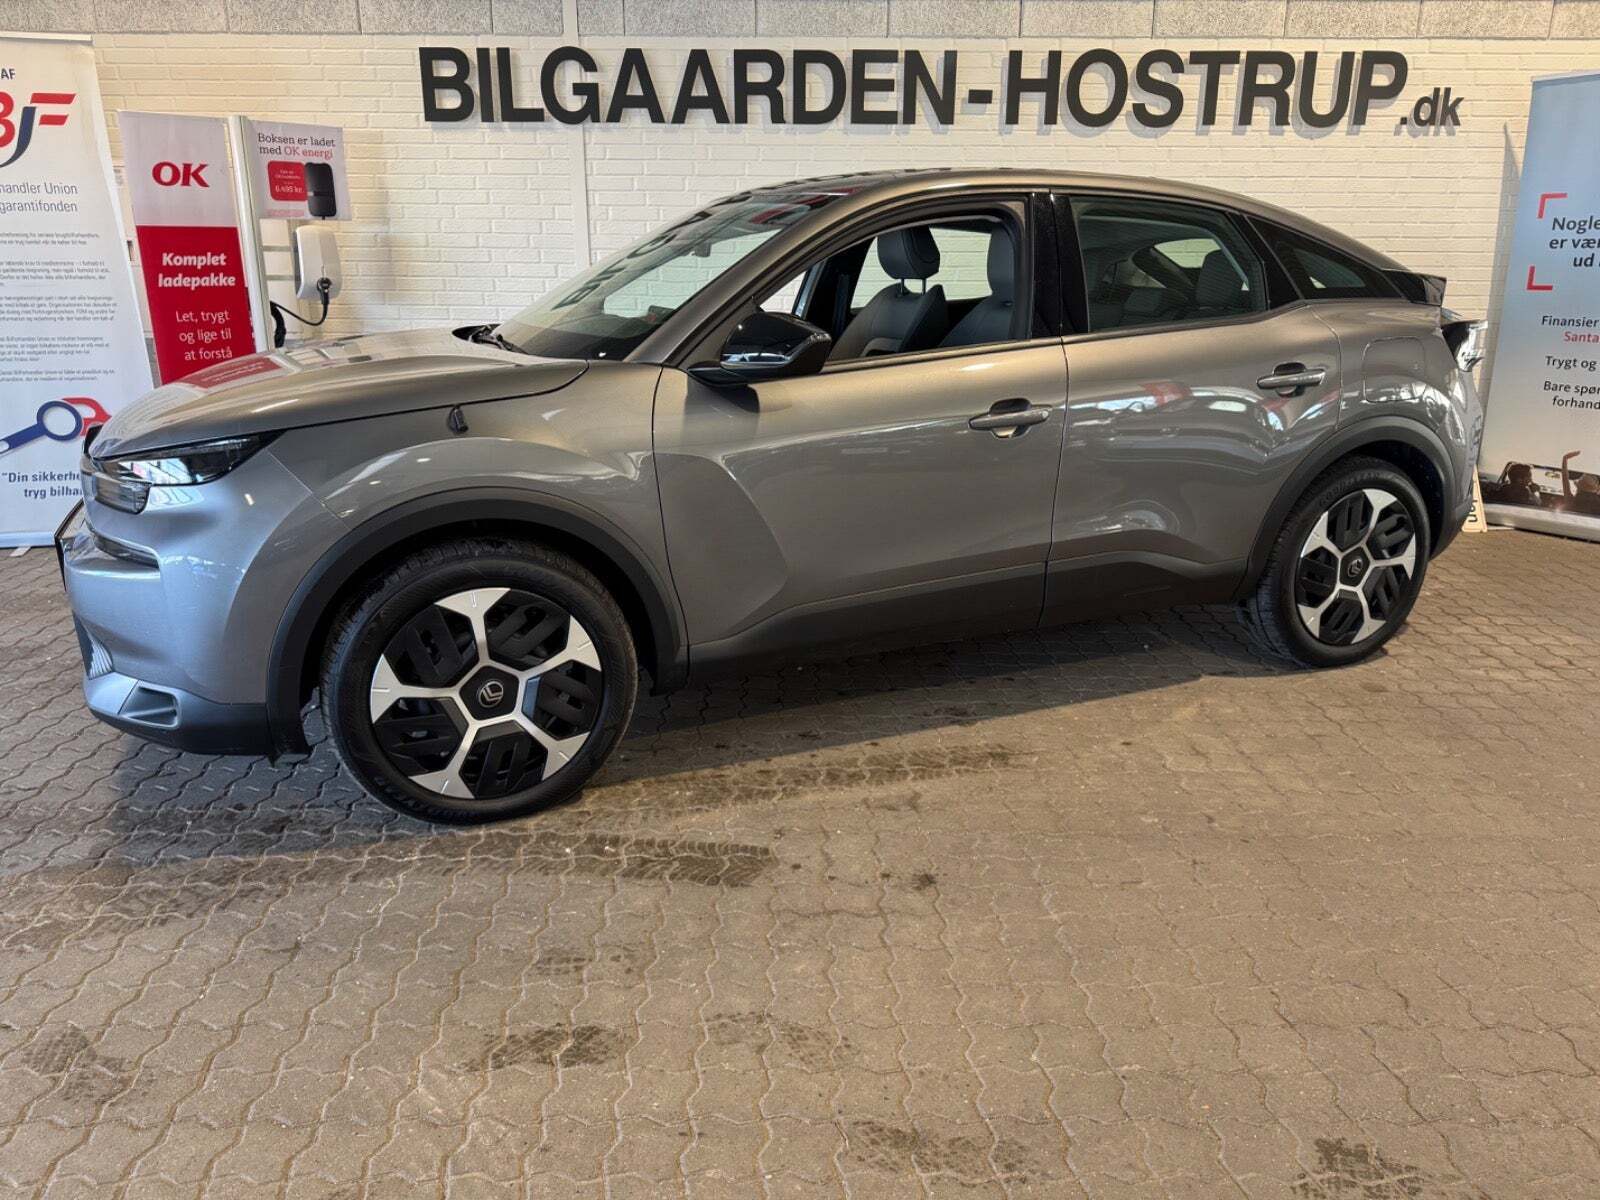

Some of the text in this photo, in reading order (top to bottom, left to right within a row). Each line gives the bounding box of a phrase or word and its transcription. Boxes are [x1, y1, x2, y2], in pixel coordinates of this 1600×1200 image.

[1, 68, 16, 80] AF
[258, 132, 336, 147] Boksen er ladet
[259, 145, 333, 160] med OK energi
[151, 161, 210, 188] OK
[44, 182, 78, 194] Union
[0, 200, 78, 214] garantifonden
[1552, 216, 1600, 234] Nogle
[1549, 238, 1568, 249] er
[162, 252, 227, 269] Komplet
[1573, 253, 1595, 267] ud
[158, 272, 236, 291] ladepakke
[176, 310, 230, 324] Let, trygt
[1541, 316, 1600, 328] Finansier
[179, 328, 231, 344] og lige til
[1563, 332, 1600, 343] Santa
[184, 346, 233, 361] at forstå
[1545, 355, 1597, 372] Trygt og
[1543, 381, 1571, 393] Bare
[24, 488, 47, 499] tryg
